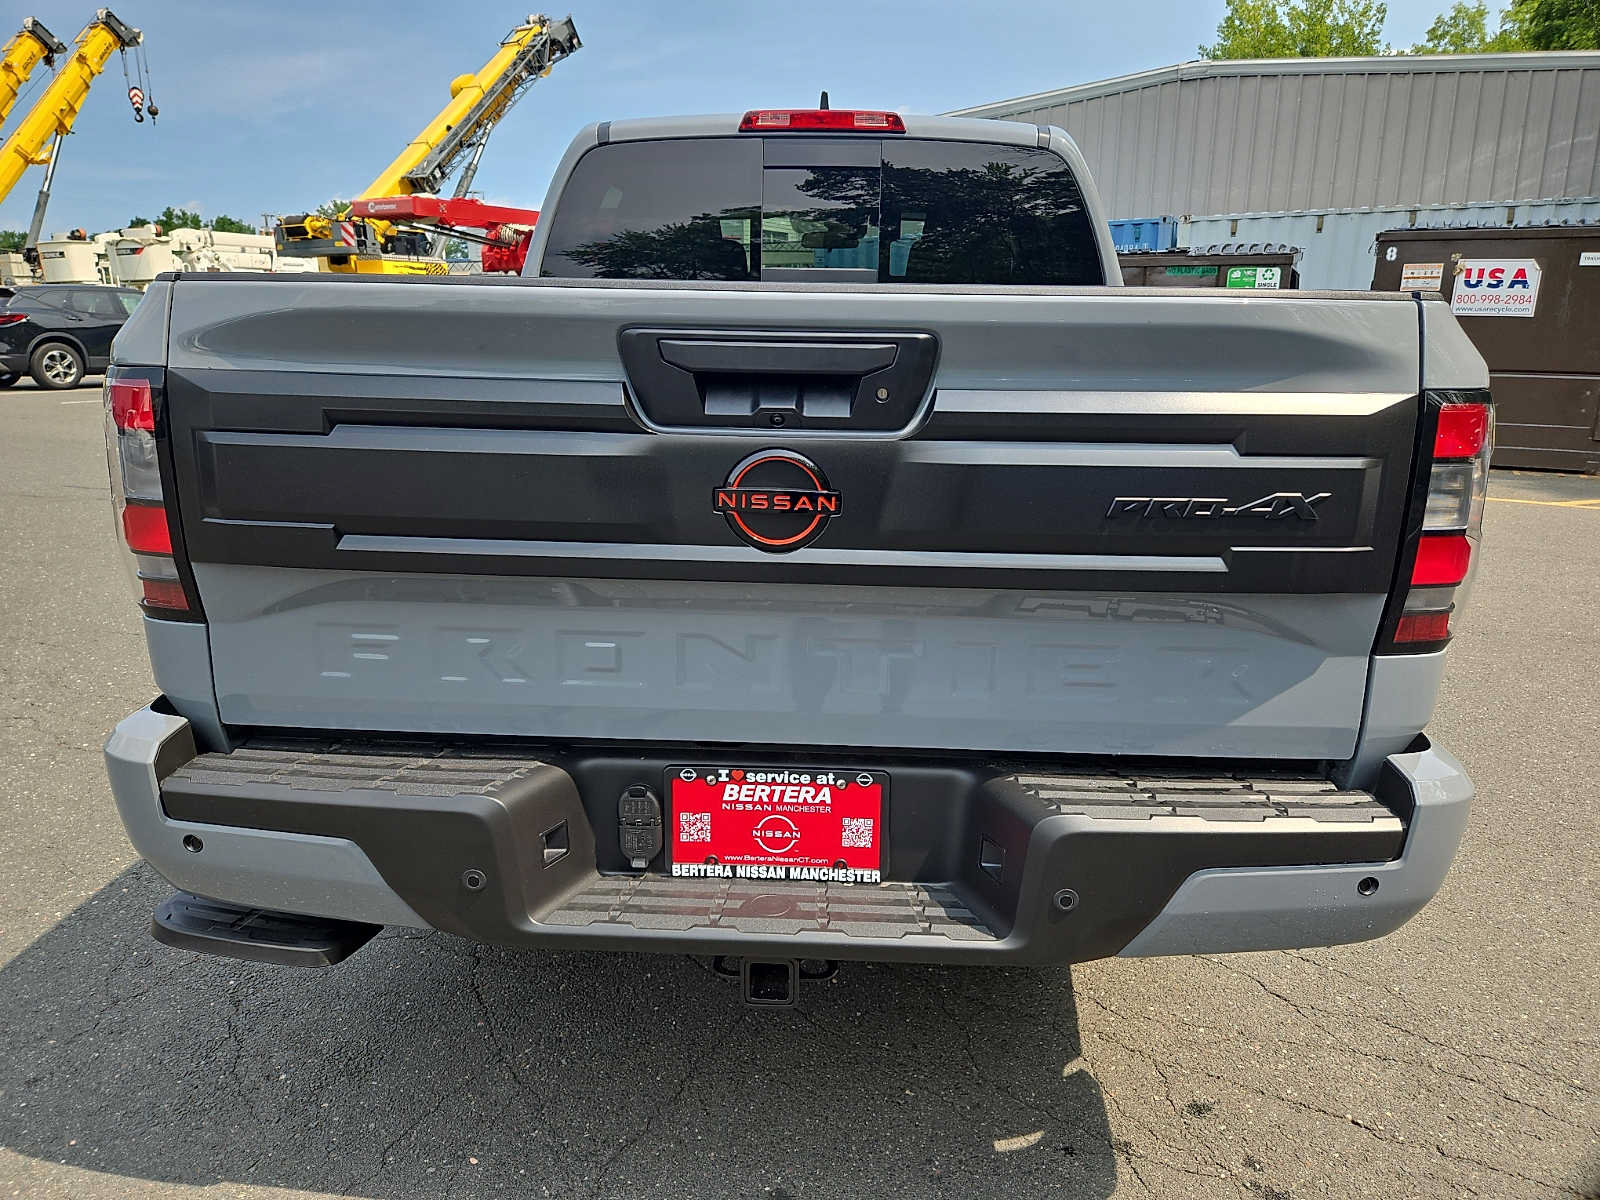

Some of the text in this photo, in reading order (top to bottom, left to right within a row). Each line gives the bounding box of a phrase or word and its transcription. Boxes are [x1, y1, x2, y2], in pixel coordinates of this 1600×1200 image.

[1386, 246, 1398, 261] 8
[1464, 268, 1530, 289] USA
[1456, 294, 1533, 305] 800-998-2984
[718, 492, 836, 512] NISSAN
[1106, 492, 1332, 520] PRO-4X
[315, 622, 1254, 703] FRONTIER
[718, 769, 836, 785] I service at
[722, 783, 832, 805] BERTERA
[721, 803, 832, 813] NISSAN MANCHESTER
[752, 830, 801, 839] NISSAN
[671, 864, 881, 883] BERTERA NISSAN MANCHESTER
